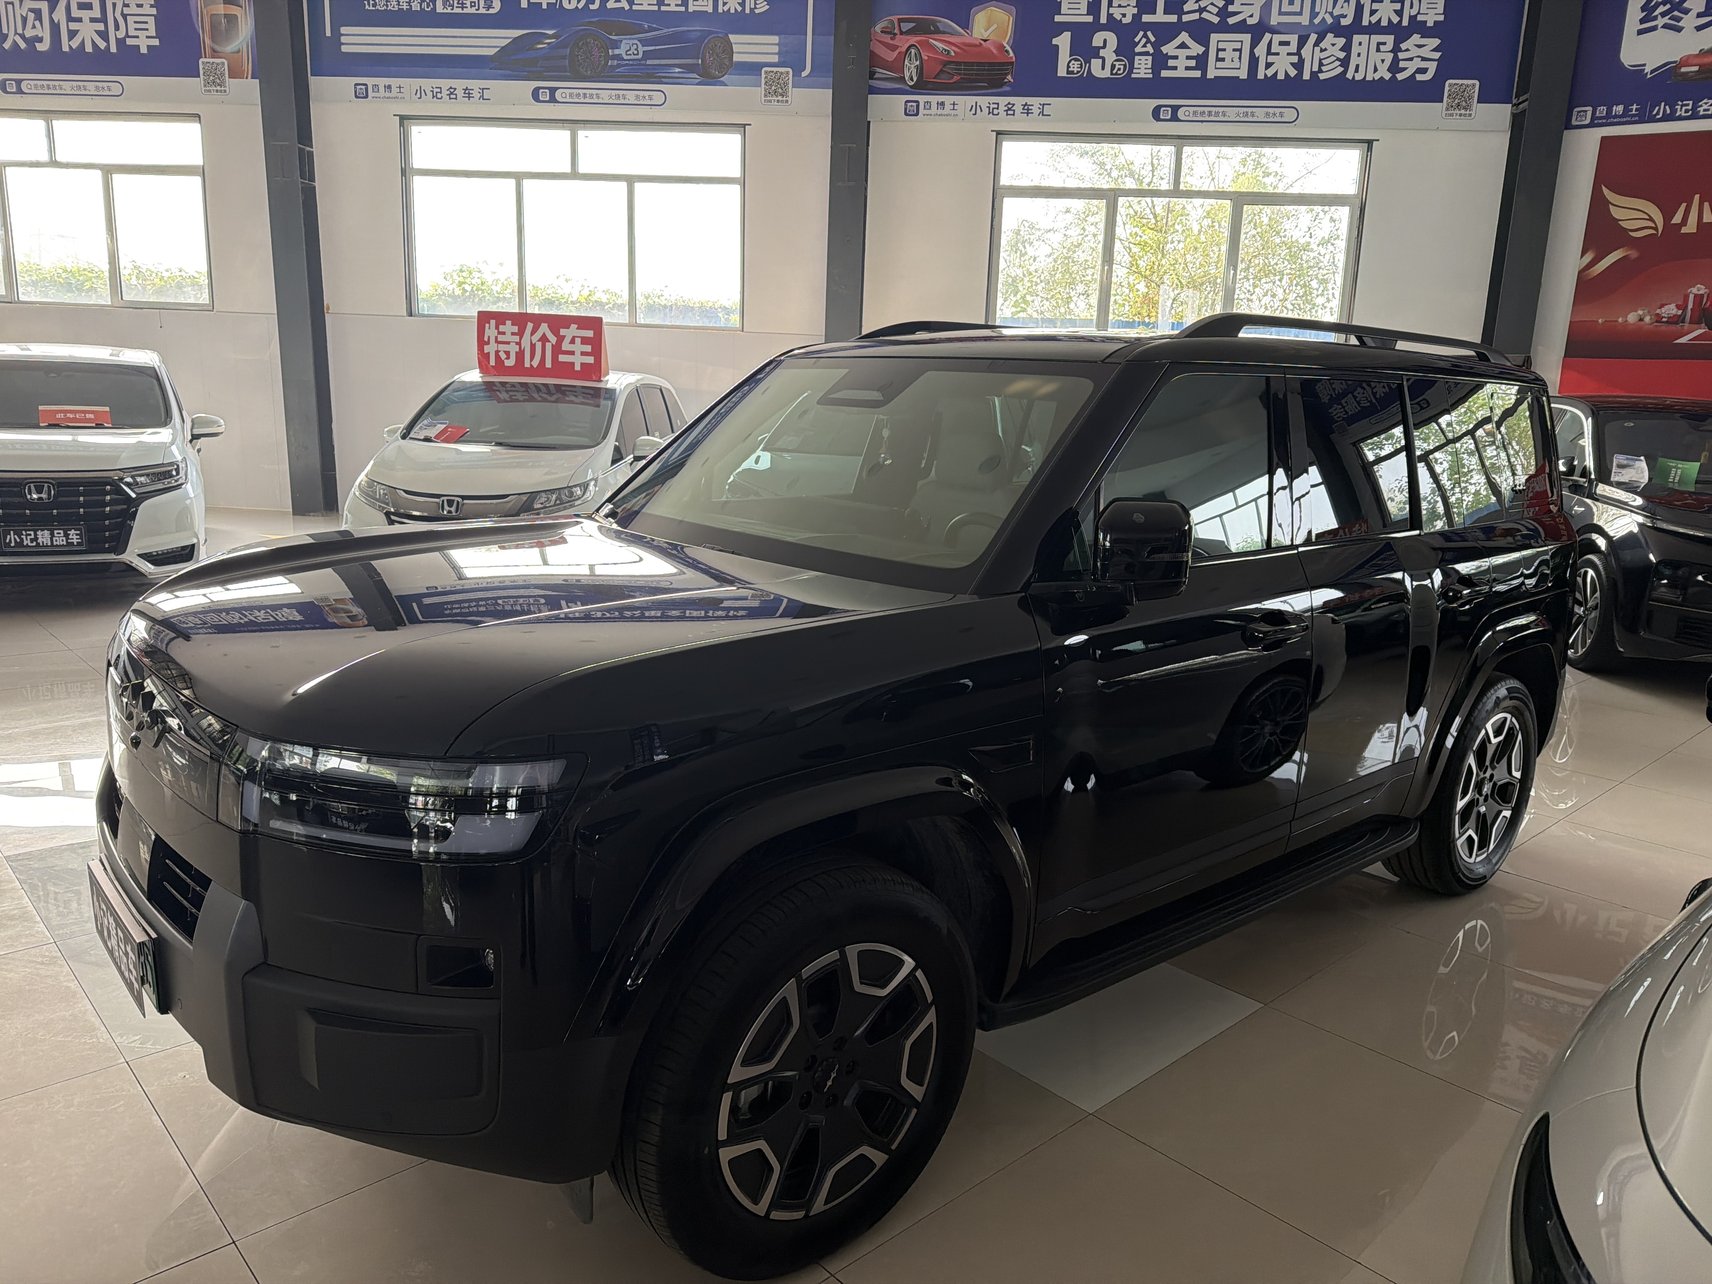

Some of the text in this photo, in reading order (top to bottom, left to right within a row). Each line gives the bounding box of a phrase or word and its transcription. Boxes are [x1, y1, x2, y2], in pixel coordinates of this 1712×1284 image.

[0, 0, 160, 53] 购保障
[625, 42, 640, 56] 23
[414, 85, 491, 101] 小记名车汇
[968, 101, 1052, 117] 小记名车汇
[484, 319, 595, 371] 特价车
[6, 529, 82, 547] 小记精品车
